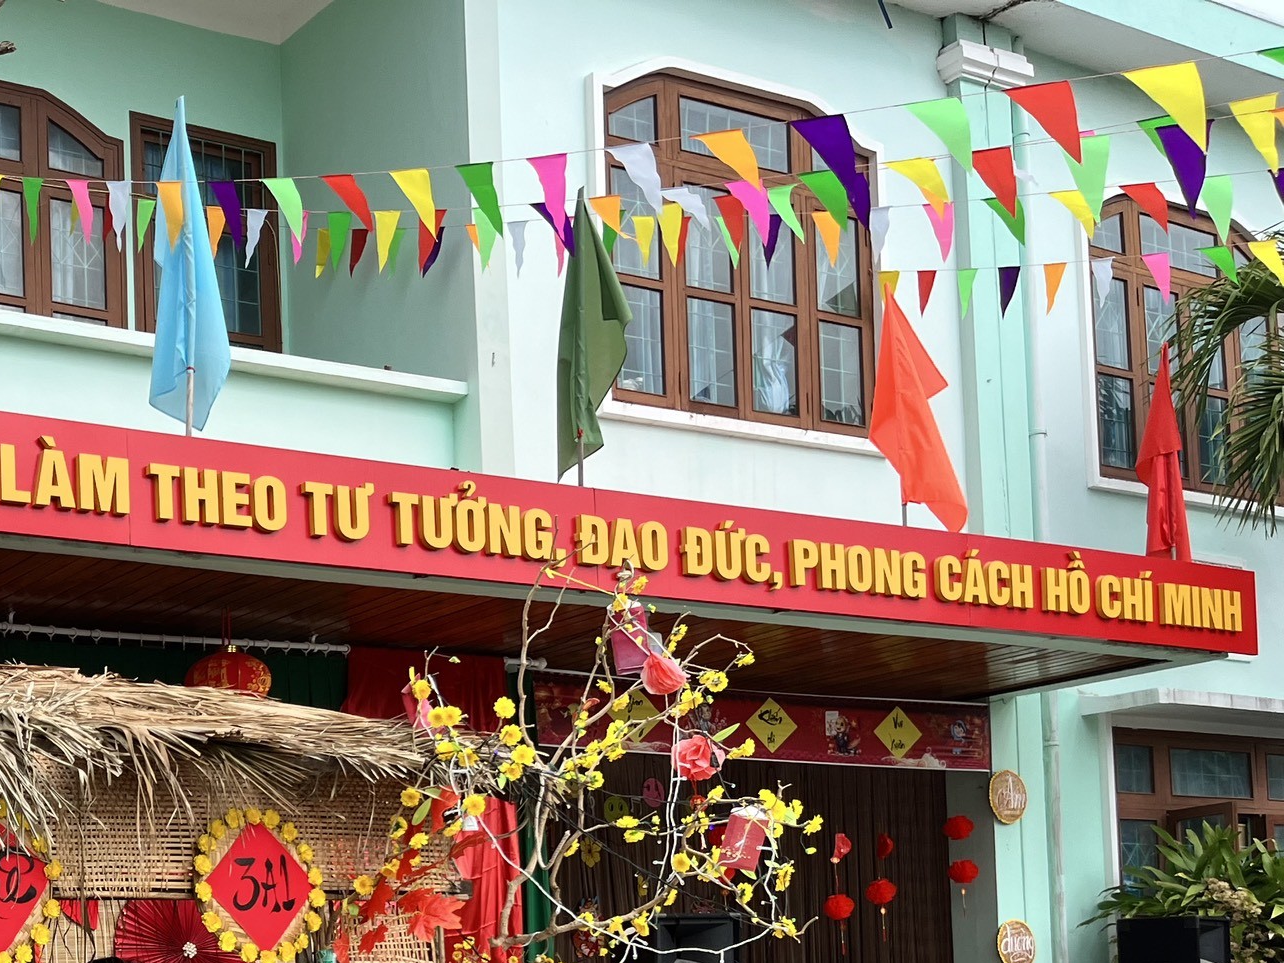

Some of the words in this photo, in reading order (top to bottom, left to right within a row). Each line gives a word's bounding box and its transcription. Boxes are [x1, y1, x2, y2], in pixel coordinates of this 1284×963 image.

[144, 462, 288, 533] THEO
[300, 481, 375, 543] TƯ
[388, 480, 567, 568] TƯỞNG,
[679, 520, 783, 591] ĐỨC,
[788, 538, 927, 600] PHONG
[933, 549, 1034, 610] CÁCH
[1040, 550, 1091, 615] HỒ
[1095, 570, 1154, 623] CHÍ
[1158, 582, 1243, 633] MINH
